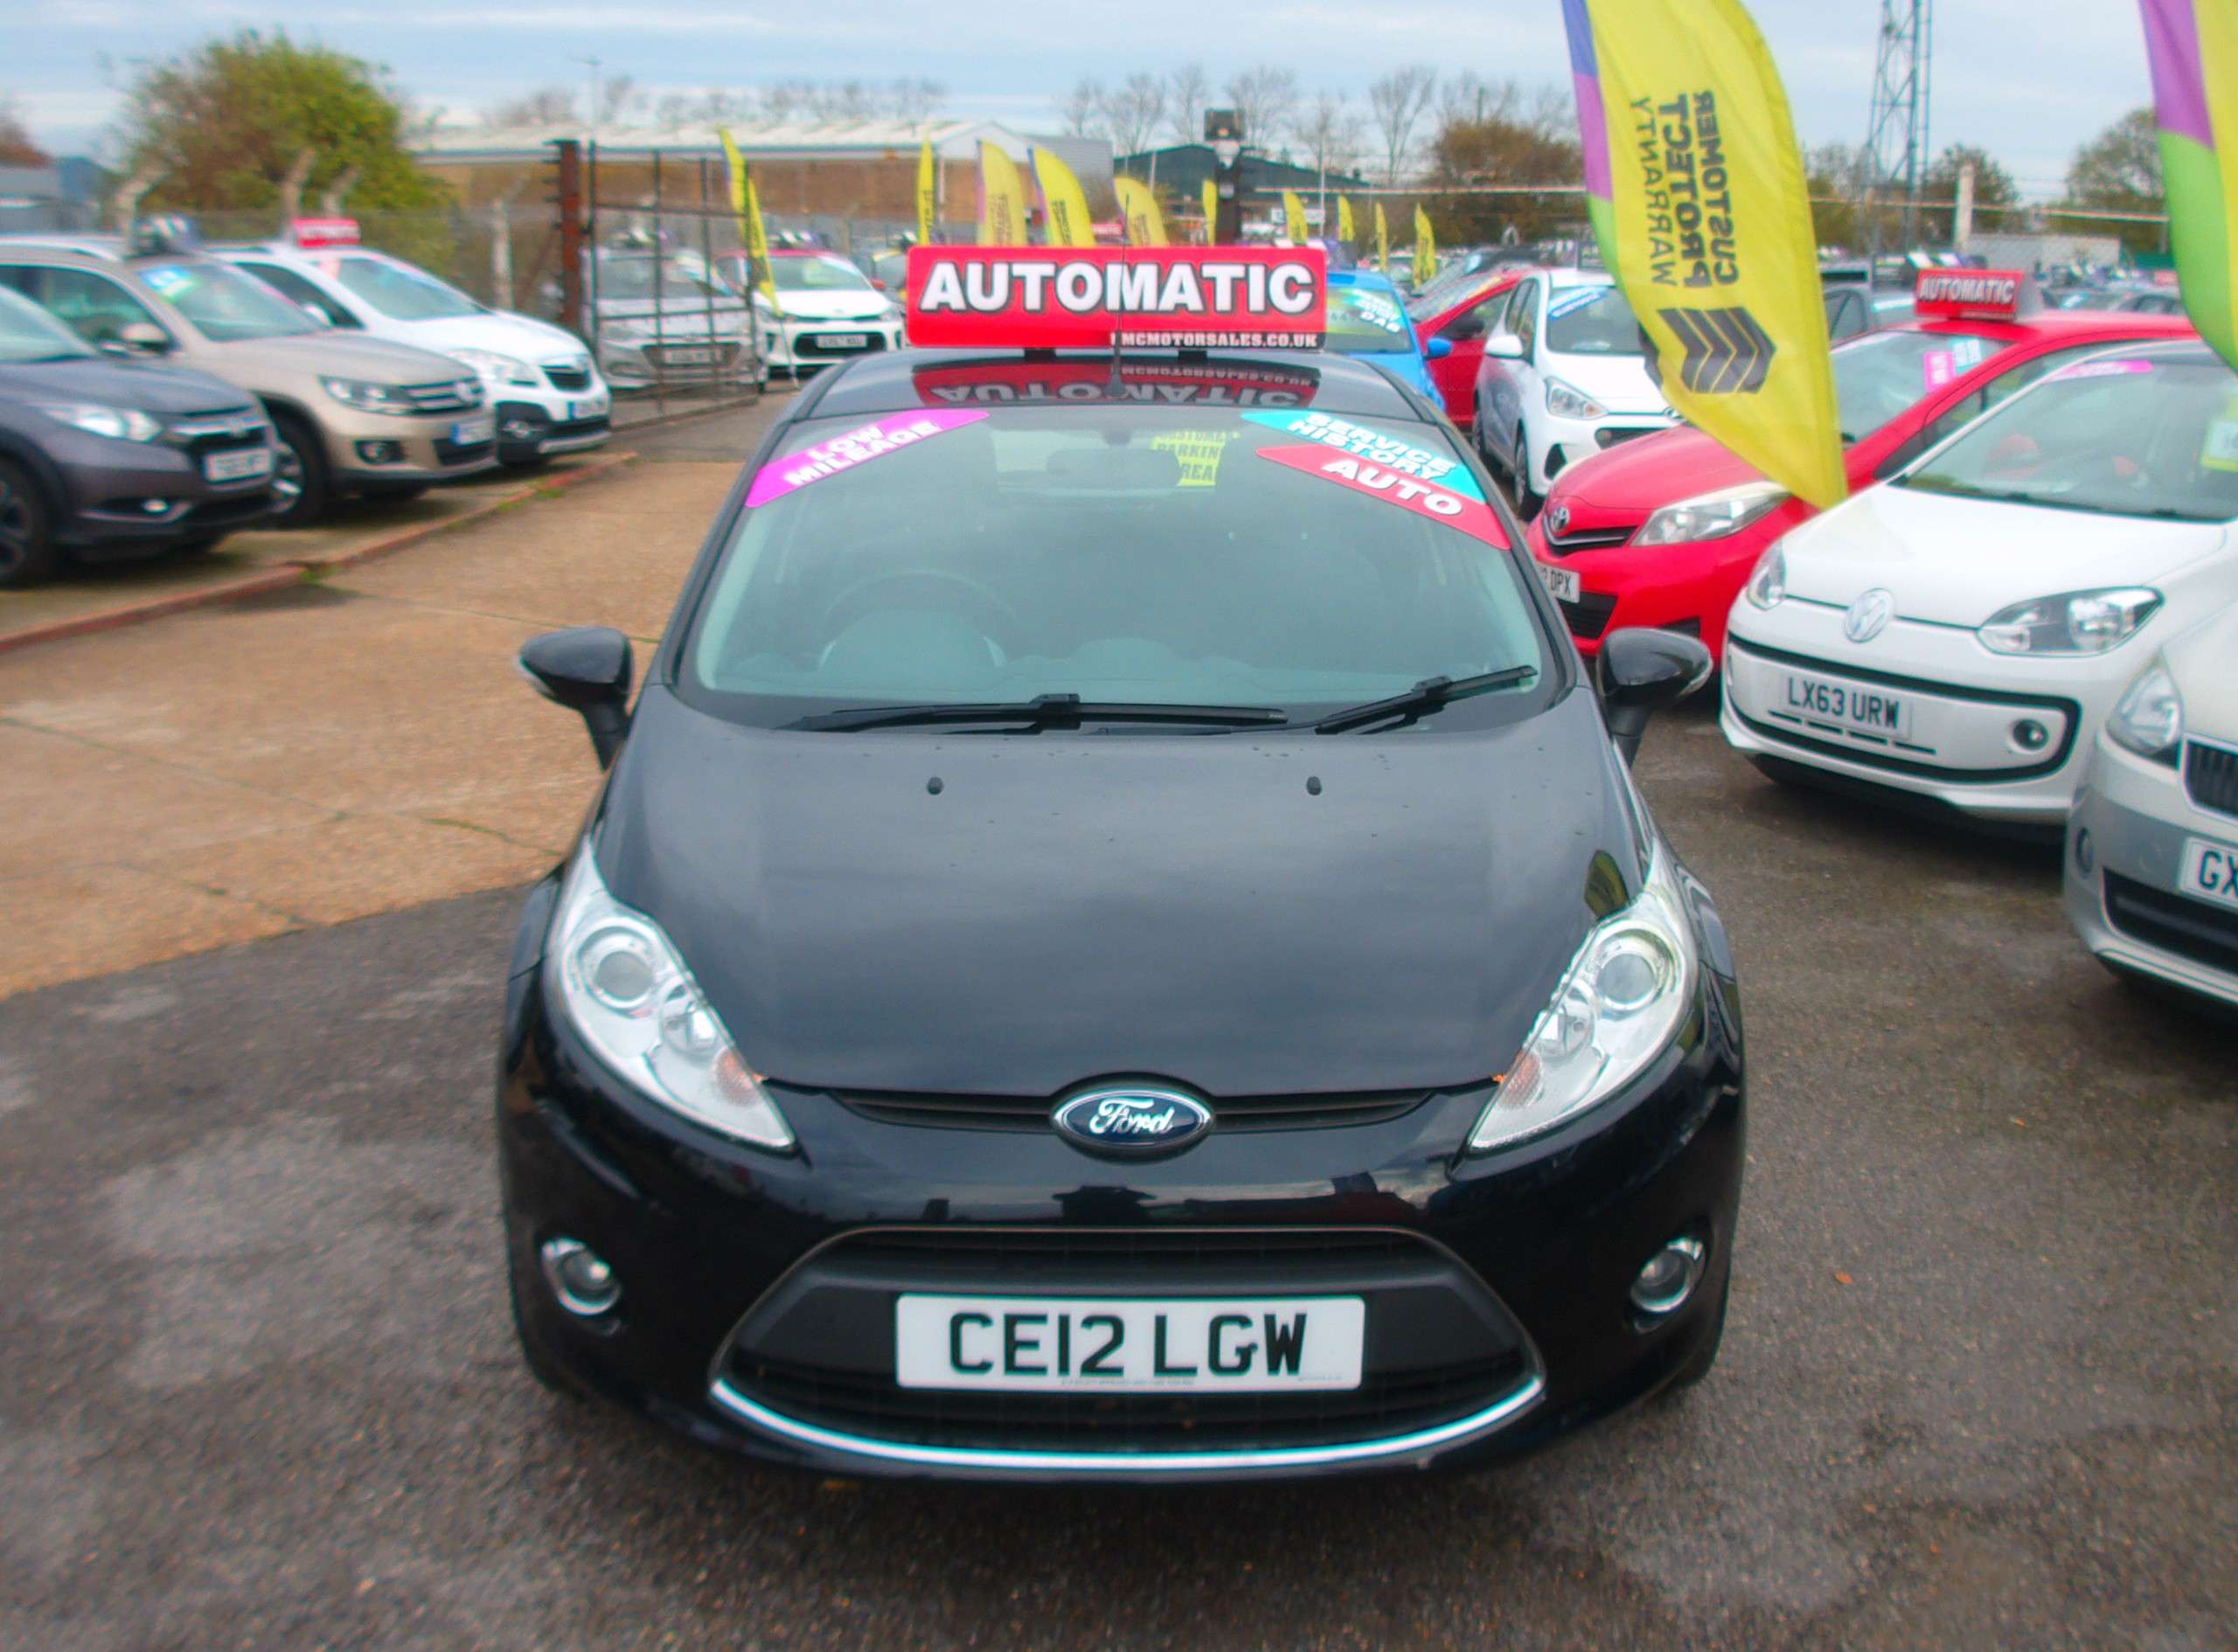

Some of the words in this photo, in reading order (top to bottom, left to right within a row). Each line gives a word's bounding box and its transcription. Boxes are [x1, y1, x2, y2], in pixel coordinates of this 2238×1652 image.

[920, 260, 1316, 314] AUTOMATIC
[1920, 276, 2016, 305] AUTOMATIC
[784, 420, 942, 486] MILEAGE
[805, 424, 886, 461] LOW
[1287, 420, 1448, 481] HISTORY
[1306, 411, 1457, 474] SERVICE
[1323, 458, 1463, 516] AUTO
[1788, 677, 1845, 717] LX63
[1852, 691, 1900, 729] URW
[1088, 1096, 1176, 1135] Ford
[949, 1313, 1126, 1378] CE12
[1153, 1313, 1308, 1378] LGW
